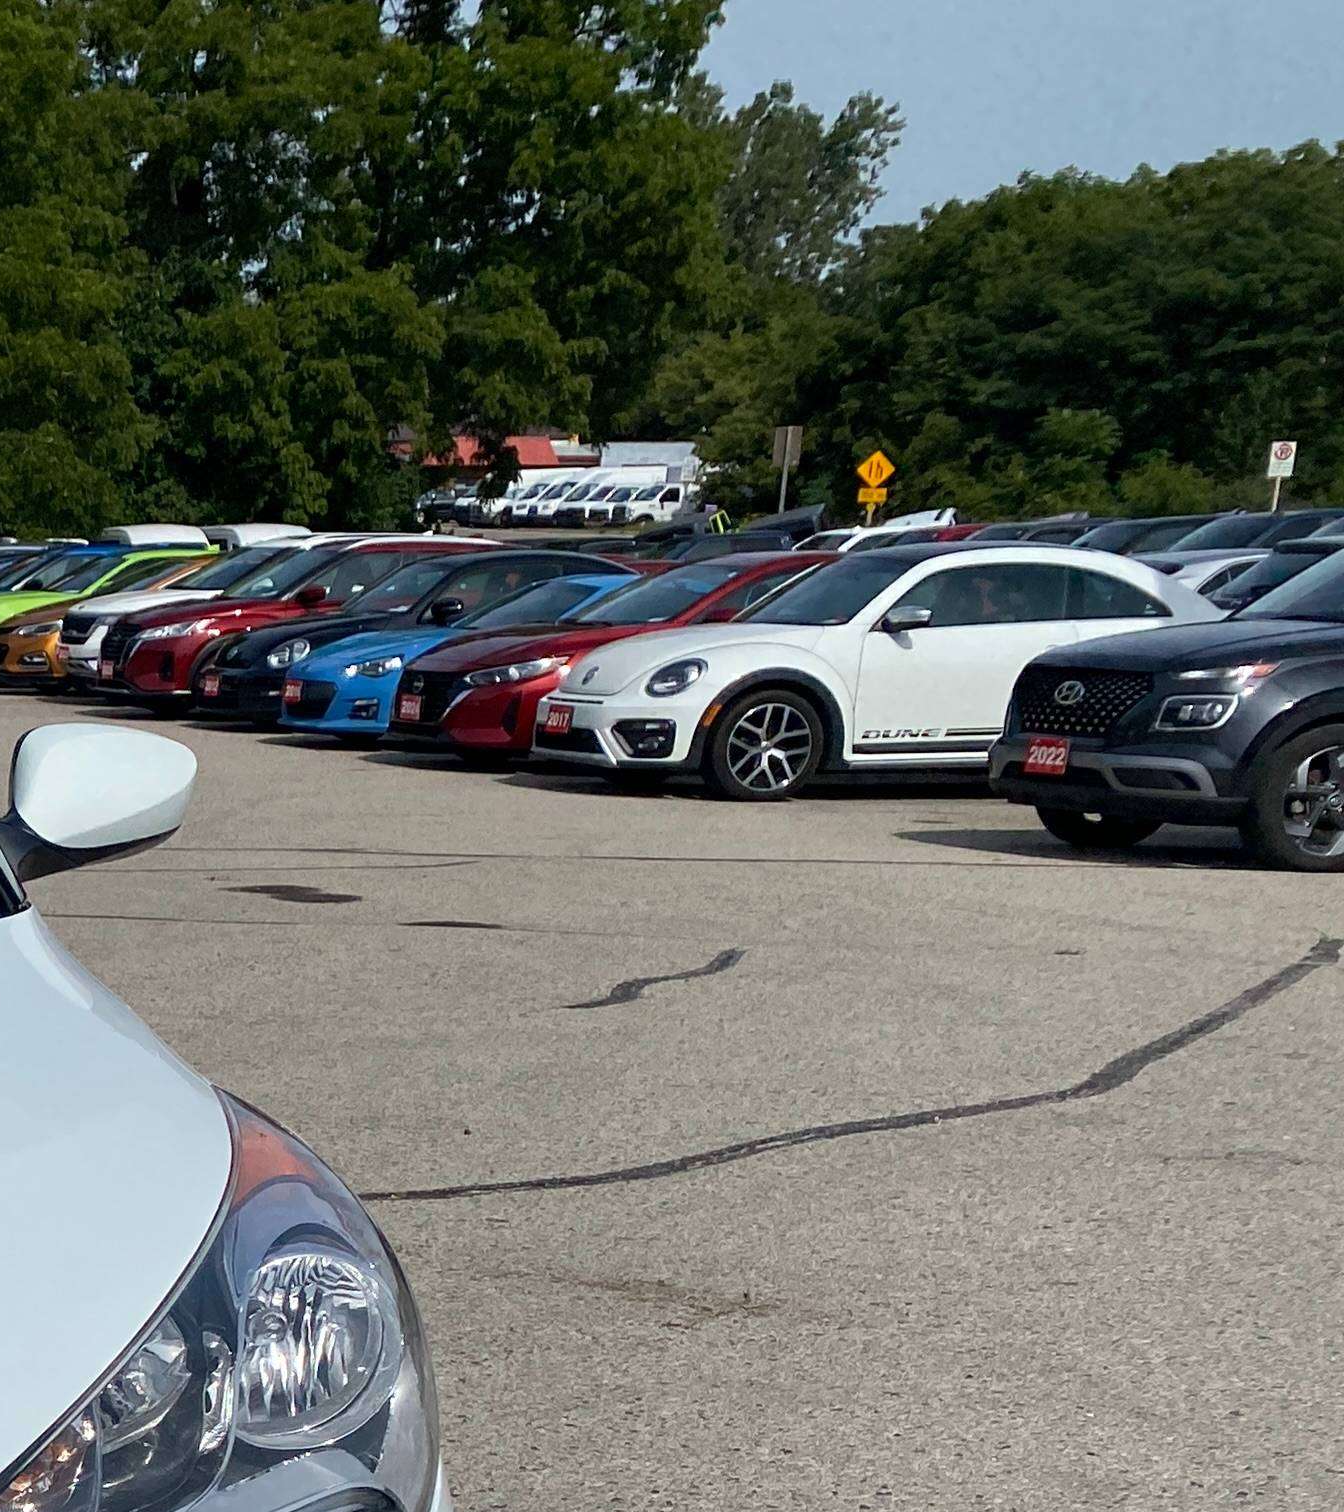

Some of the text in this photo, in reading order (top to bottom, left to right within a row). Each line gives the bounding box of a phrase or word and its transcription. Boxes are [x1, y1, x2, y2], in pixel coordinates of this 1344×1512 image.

[547, 711, 570, 727] 2017
[862, 728, 941, 739] DUNE
[1028, 745, 1066, 766] 2022
